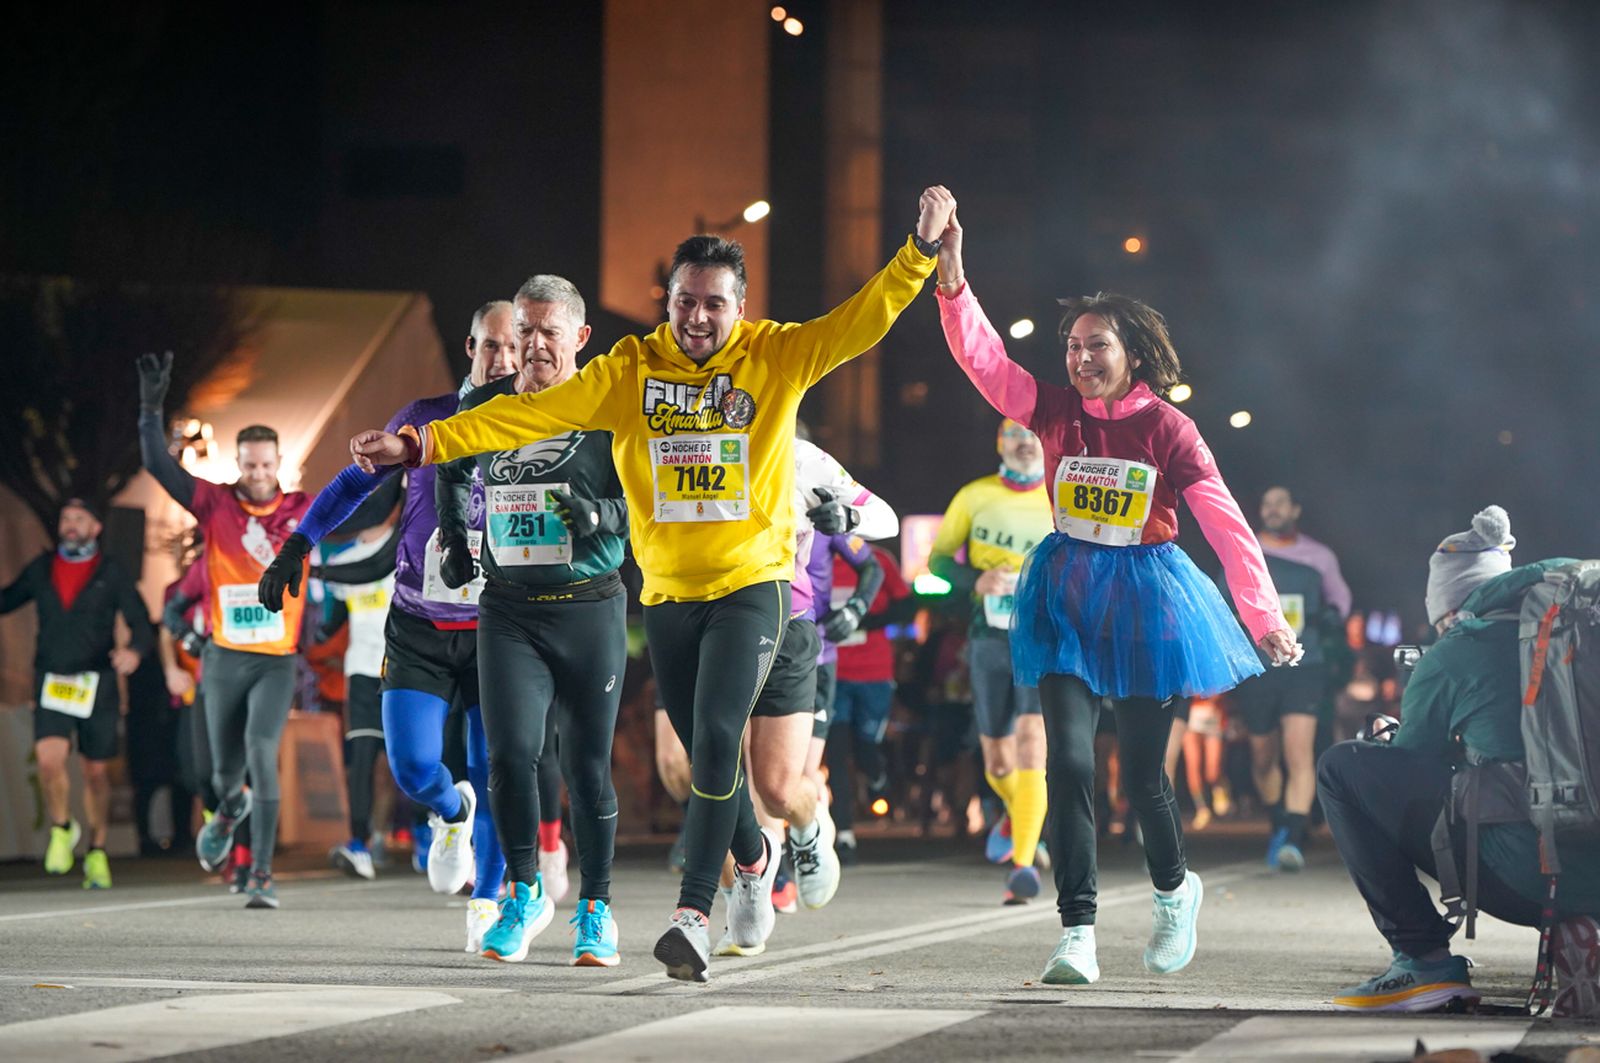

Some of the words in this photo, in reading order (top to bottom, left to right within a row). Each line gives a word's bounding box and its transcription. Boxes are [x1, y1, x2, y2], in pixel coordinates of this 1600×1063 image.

[649, 402, 724, 435] Amarilla
[672, 443, 698, 453] NOCHE
[700, 443, 712, 452] DE
[662, 455, 680, 465] SAN
[681, 453, 712, 464] ANTÓN
[674, 465, 726, 491] 7142
[1079, 465, 1107, 475] NOCHE
[1107, 468, 1120, 477] DE
[1066, 473, 1084, 483] SAN
[1085, 475, 1118, 488] ANTÓN
[503, 494, 526, 502] NOCHE
[526, 493, 537, 502] DE
[1073, 485, 1134, 517] 8367
[495, 505, 509, 513] SAN
[510, 502, 538, 512] ANTÓN
[508, 513, 545, 537] 251
[1375, 973, 1414, 991] HOKA
